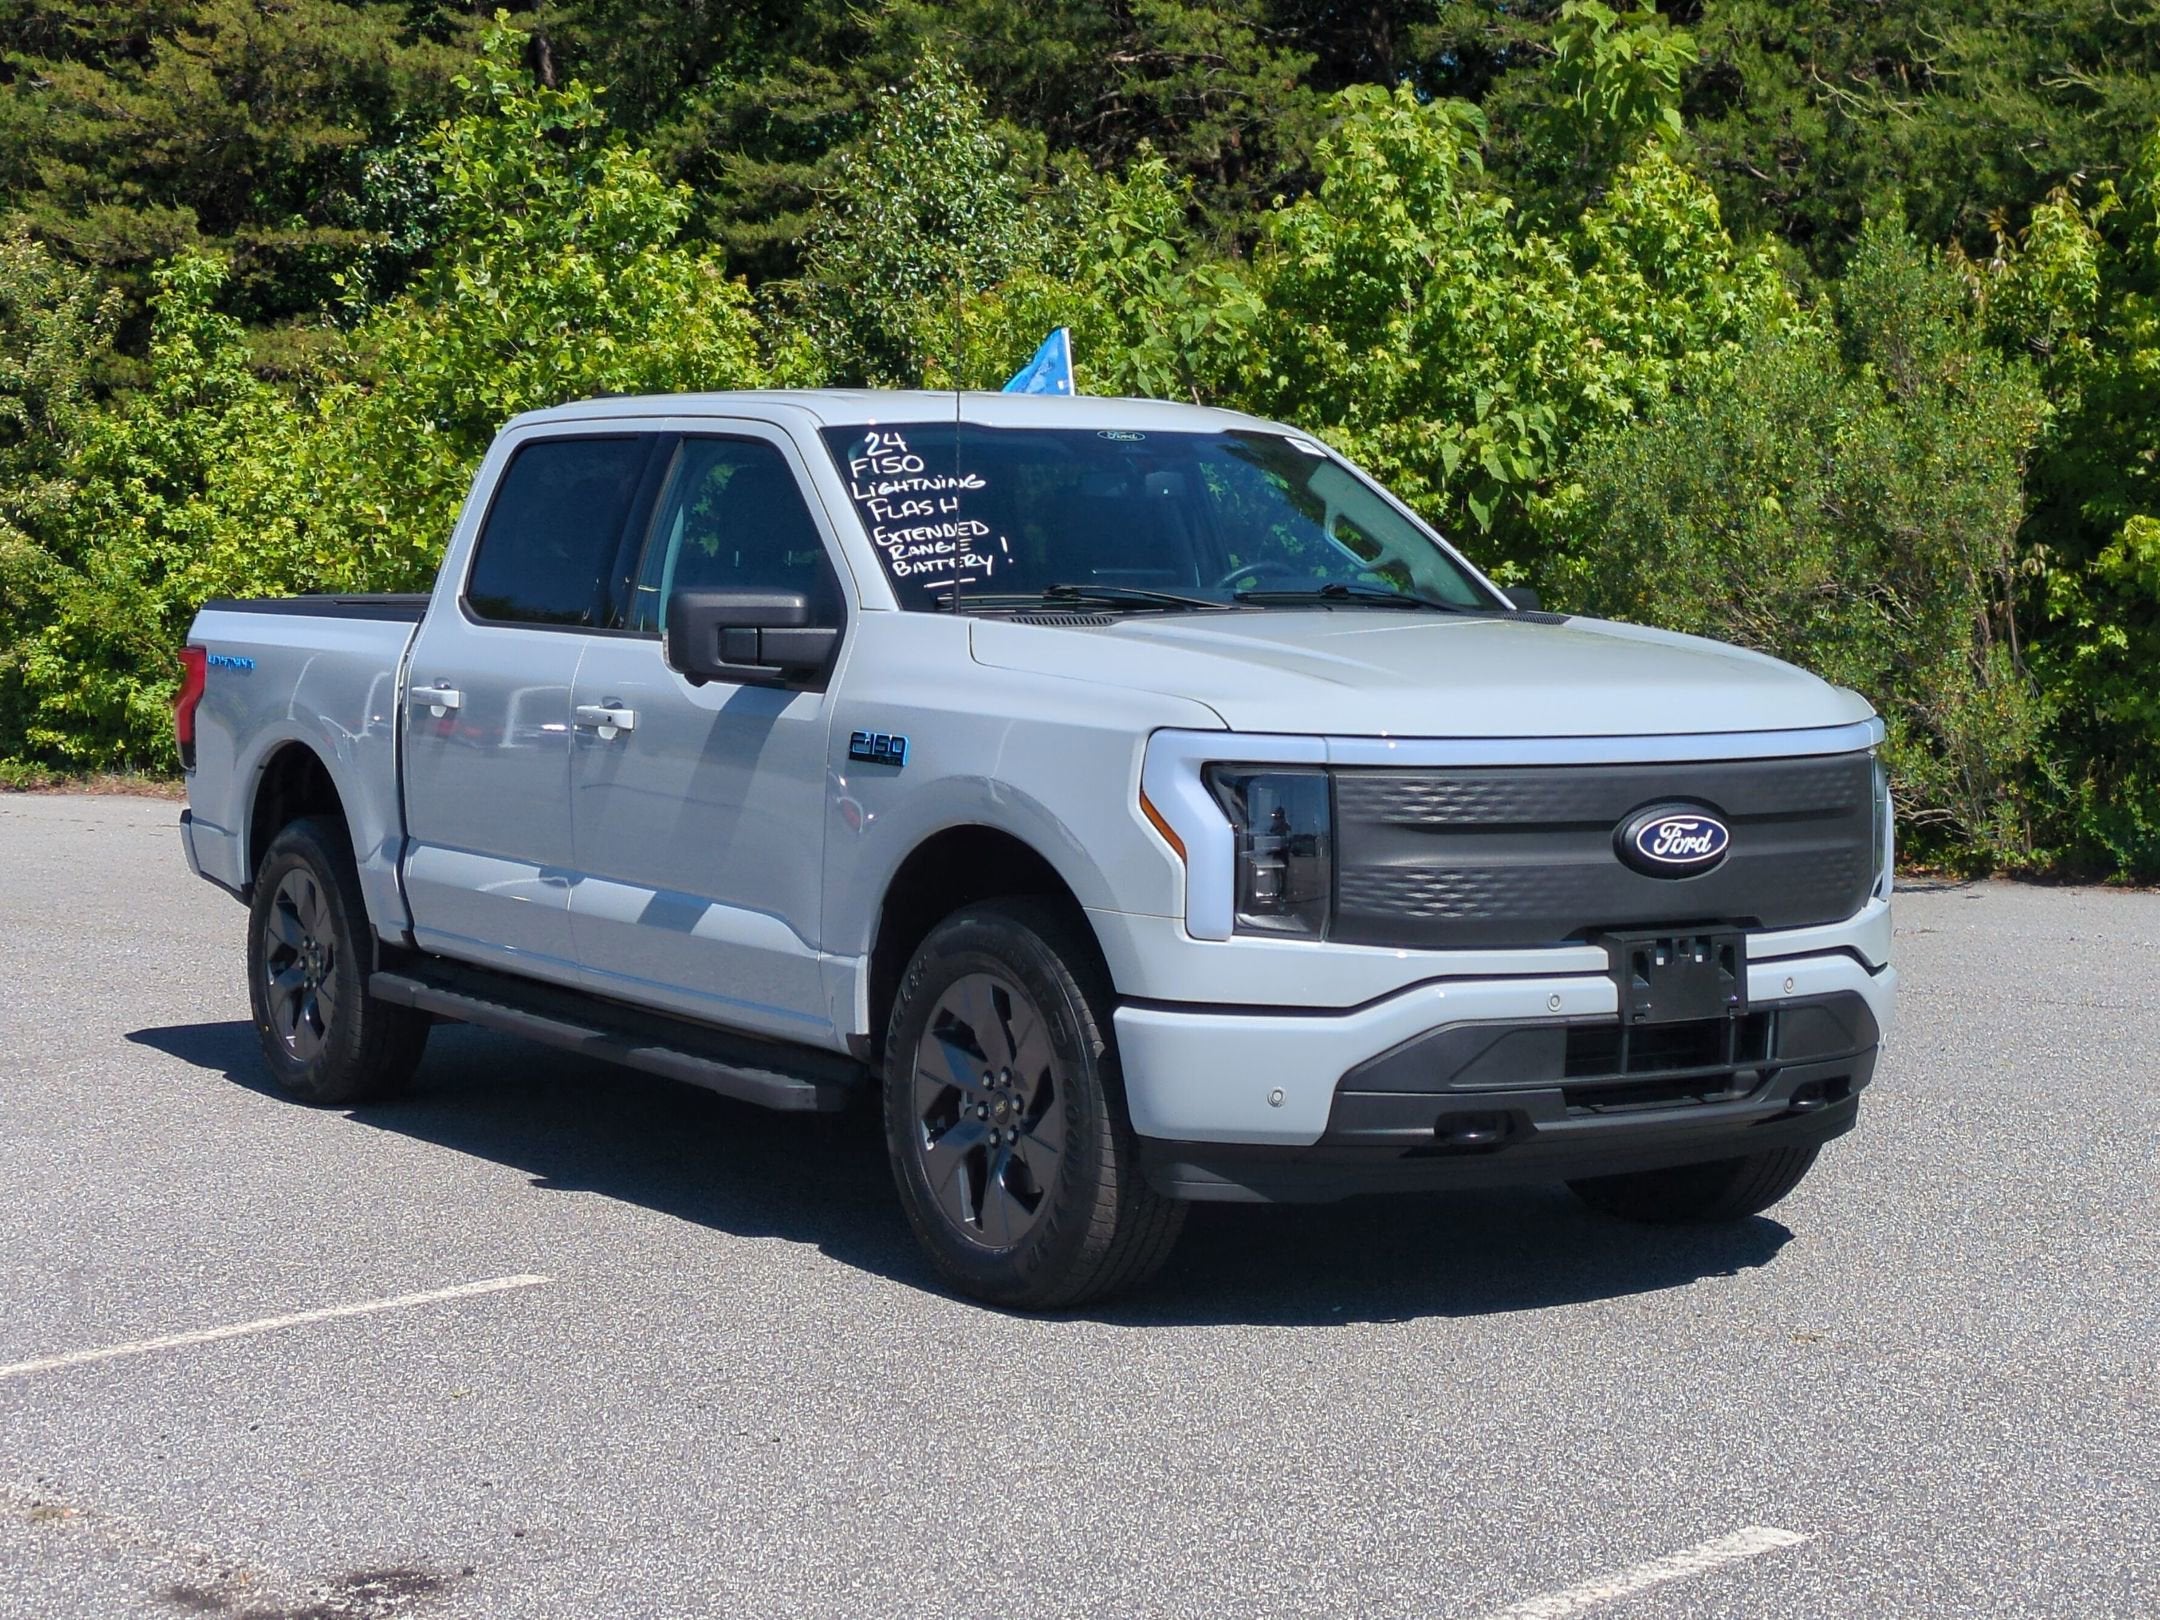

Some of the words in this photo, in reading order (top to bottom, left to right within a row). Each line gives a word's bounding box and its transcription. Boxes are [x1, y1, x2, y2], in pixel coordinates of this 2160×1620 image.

[864, 432, 907, 456] 24
[850, 455, 924, 478] F150
[866, 498, 959, 522] FLASH
[873, 520, 990, 546] EXTENDED
[888, 538, 973, 560] RANGE
[1653, 822, 1713, 855] Ford
